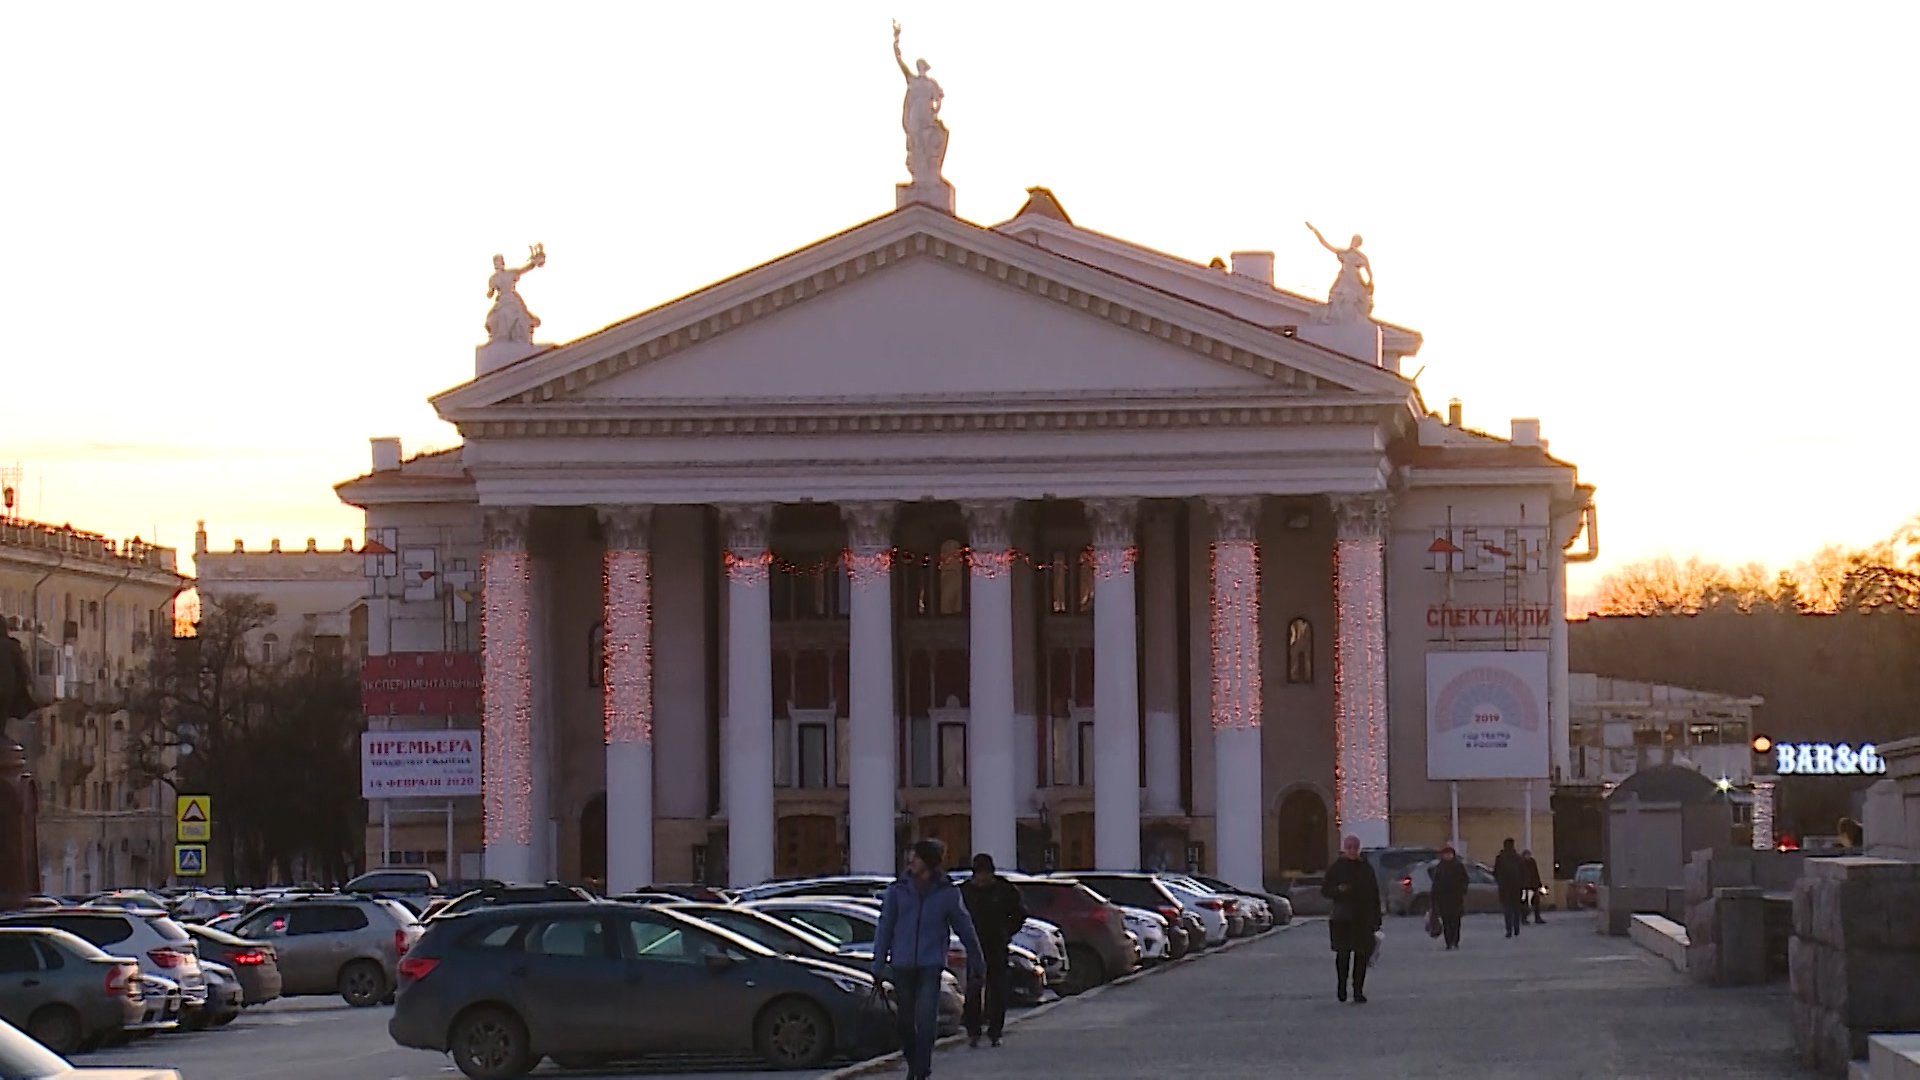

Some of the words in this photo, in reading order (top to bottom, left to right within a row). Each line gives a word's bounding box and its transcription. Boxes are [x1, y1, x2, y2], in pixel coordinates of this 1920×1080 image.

[1426, 608, 1549, 627] СПЕКТАКЛИ
[369, 740, 473, 755] ПРЕМЬЕРА
[386, 778, 442, 788] ФЕВРАЛЯ
[447, 777, 474, 786] 2020
